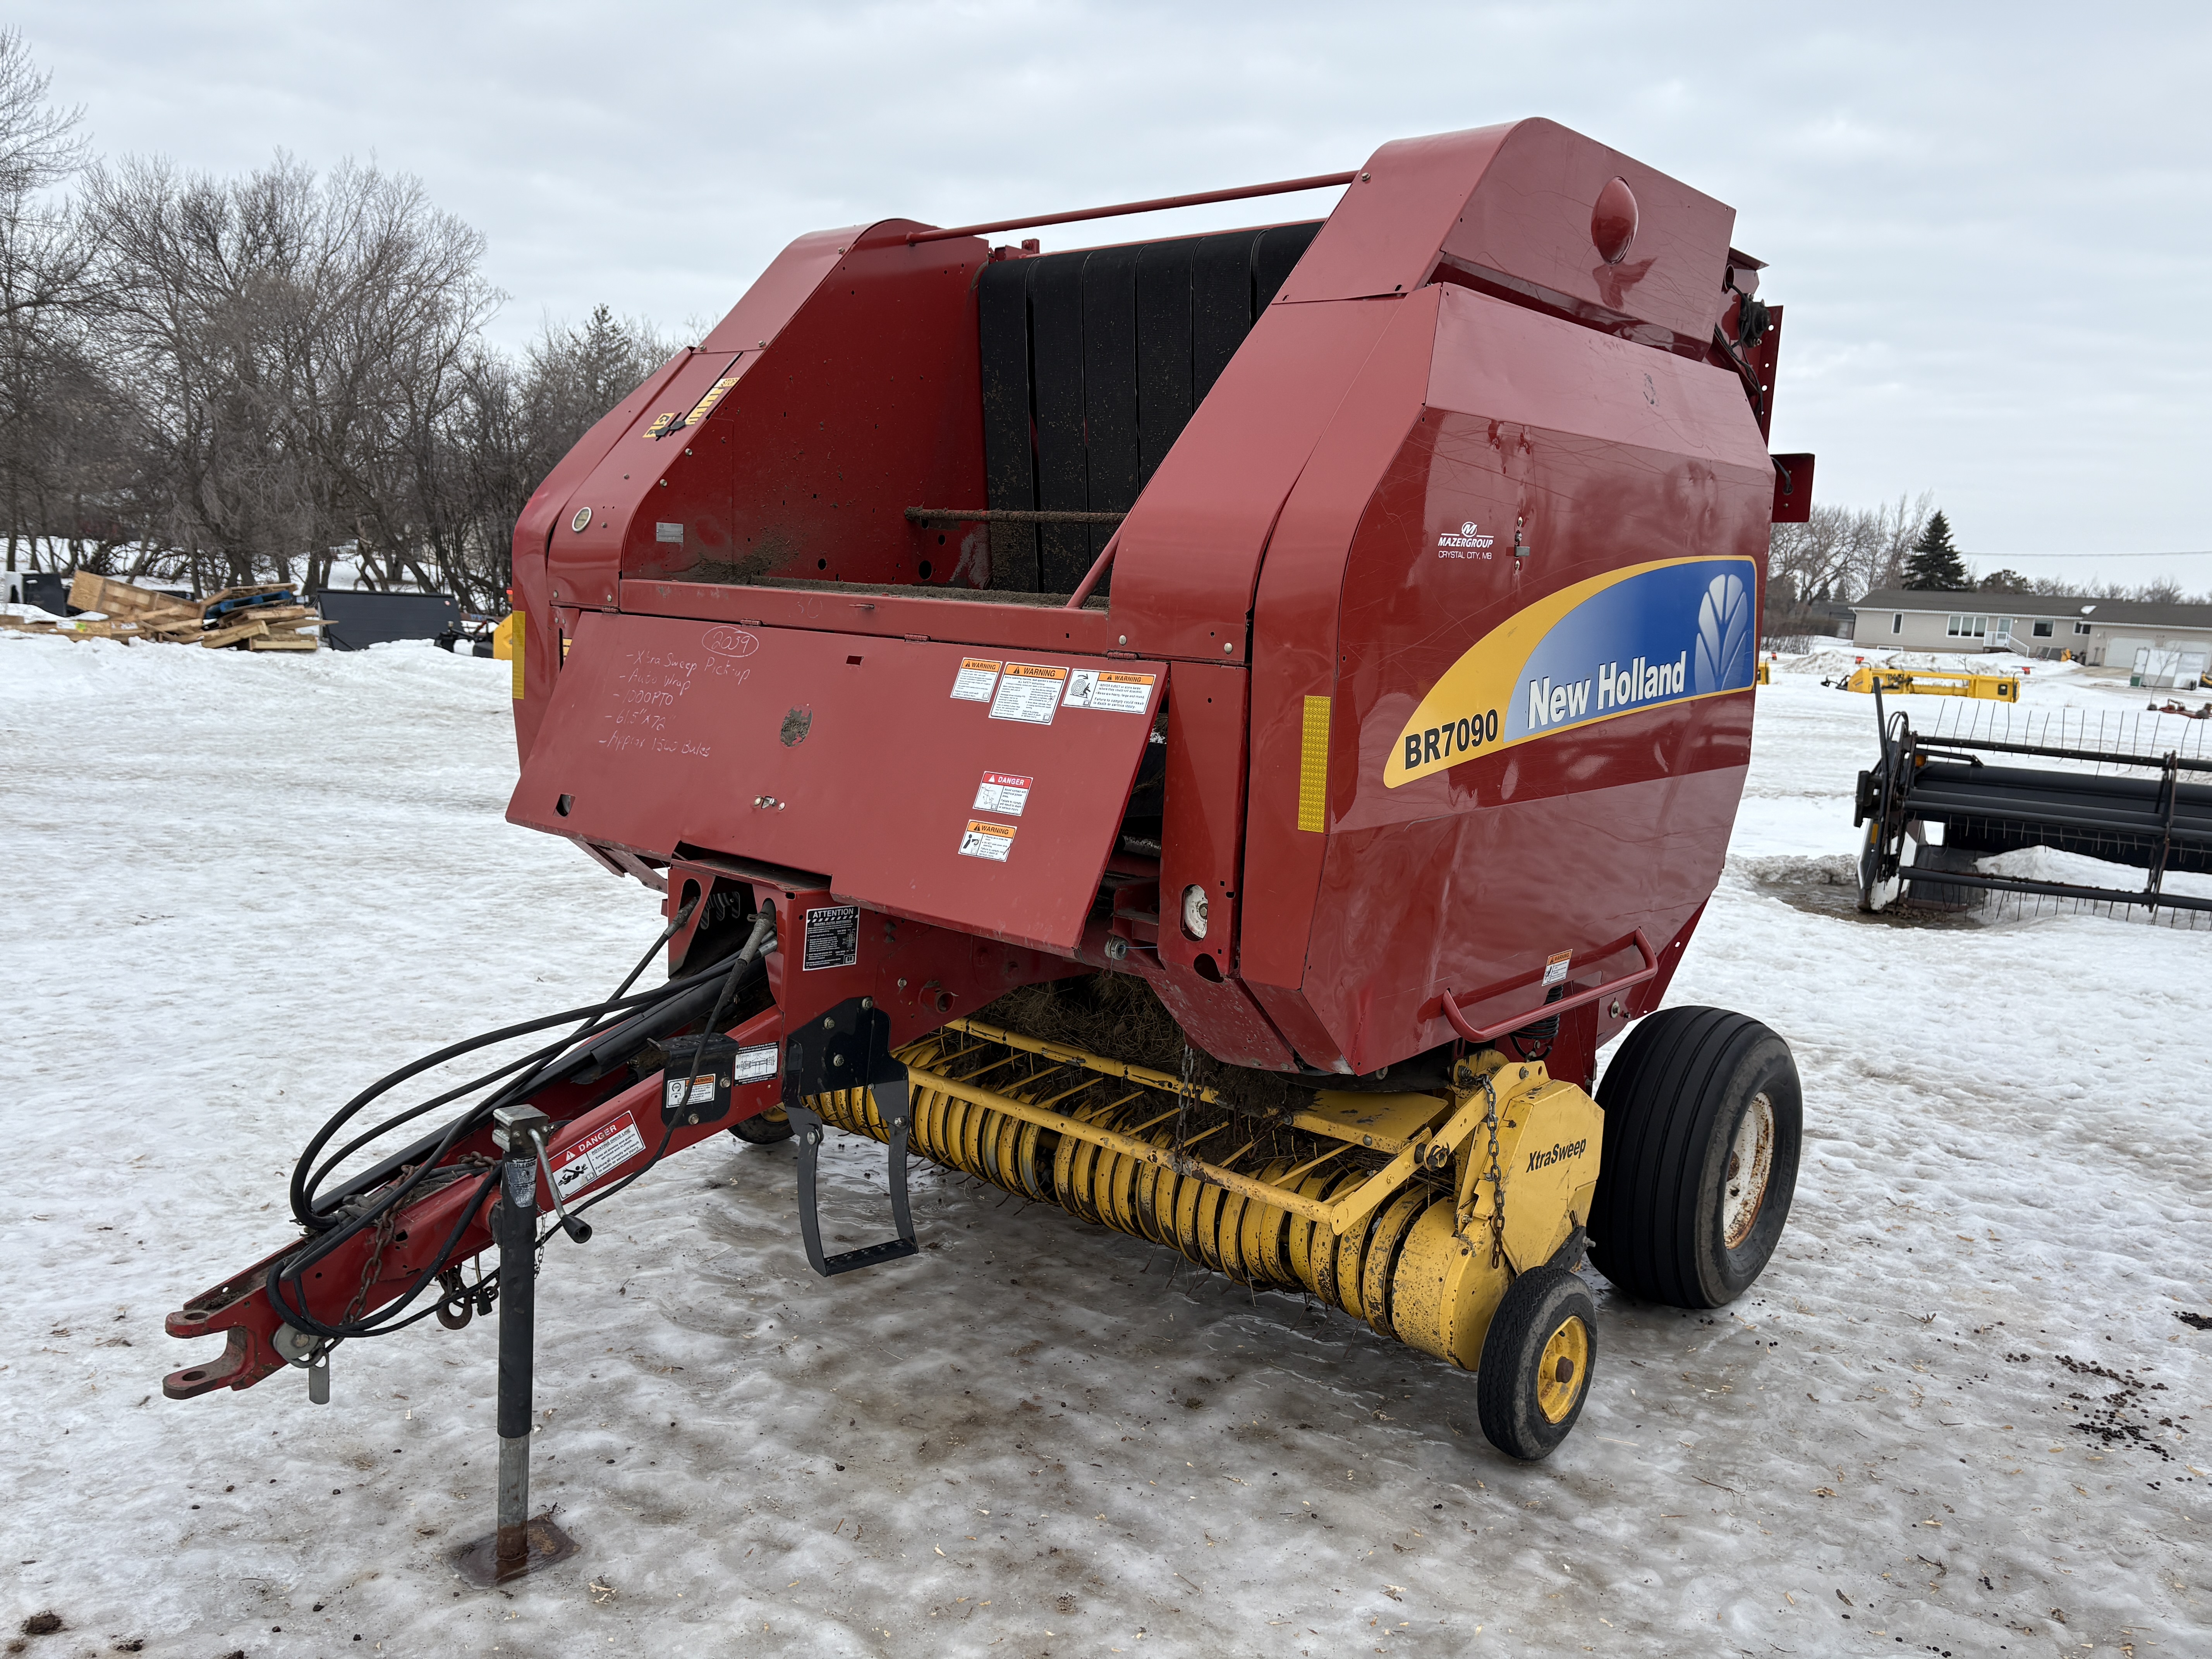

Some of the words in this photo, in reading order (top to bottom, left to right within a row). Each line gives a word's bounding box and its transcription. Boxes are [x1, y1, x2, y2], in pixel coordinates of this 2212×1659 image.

[1438, 537, 1493, 548] MAZERGROUP
[664, 653, 697, 677] Sweep
[1024, 668, 1055, 677] WARNING
[664, 673, 690, 696] Wrap
[1528, 677, 1590, 730] New
[1597, 651, 1686, 710] Holland
[682, 740, 711, 757] Bales
[1404, 709, 1498, 770] BR7090
[998, 776, 1024, 786] DANGER
[982, 825, 1009, 835] WARNING
[813, 908, 854, 918] ATTENTION
[578, 1125, 617, 1152] DANGER
[591, 1142, 610, 1155] ROTATING
[610, 1134, 621, 1143] DRIVE
[595, 1161, 607, 1170] Failure
[611, 1151, 623, 1161] comply
[1526, 1138, 1586, 1173] XtraSweep
